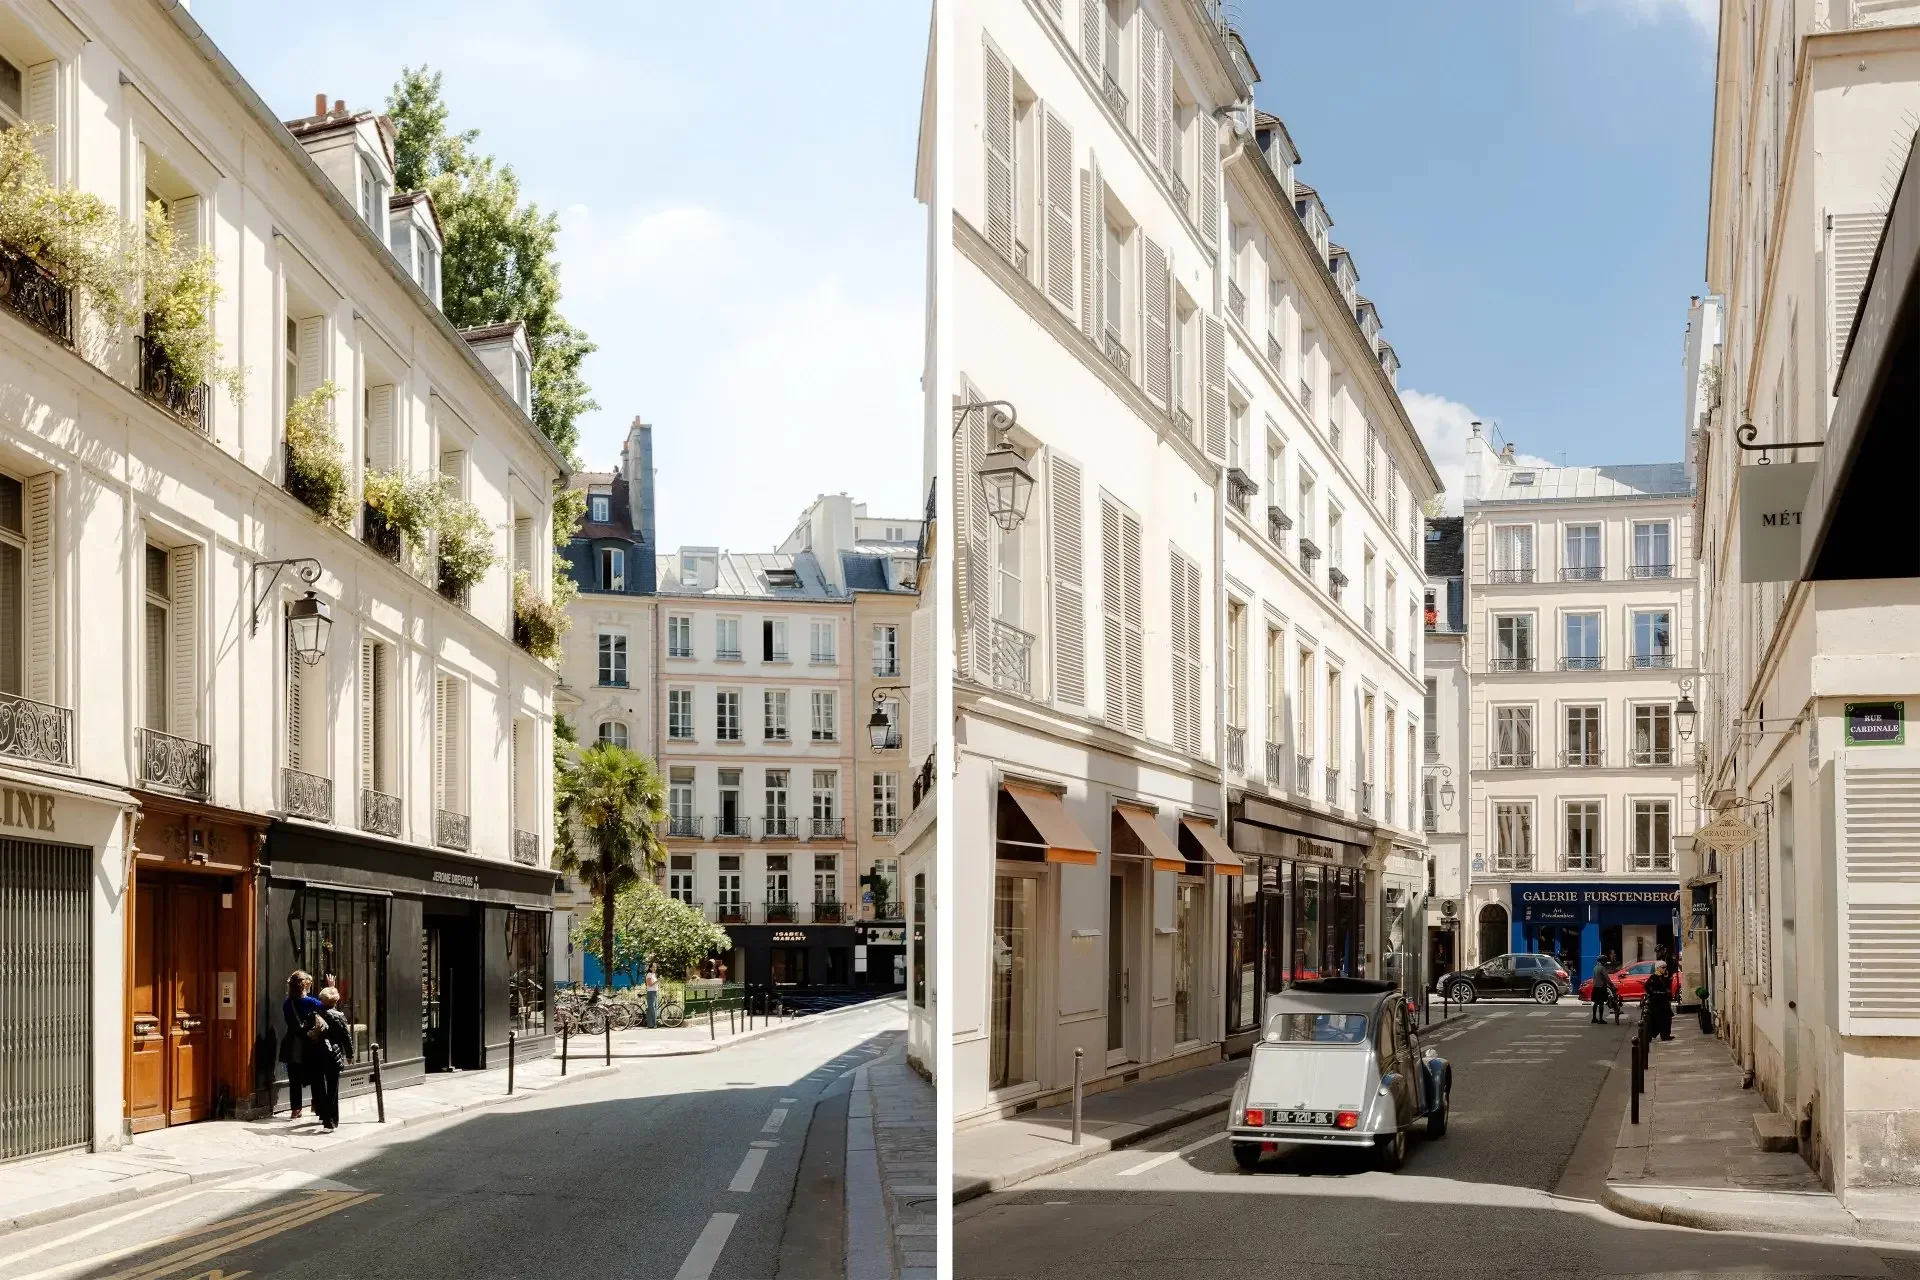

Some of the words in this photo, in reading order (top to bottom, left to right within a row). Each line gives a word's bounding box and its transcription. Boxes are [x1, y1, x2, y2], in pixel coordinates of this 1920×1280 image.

[1864, 714, 1882, 722] RUE
[1850, 724, 1899, 733] CARDINALE
[0, 786, 55, 832] INE
[1522, 891, 1578, 902] GALERIE
